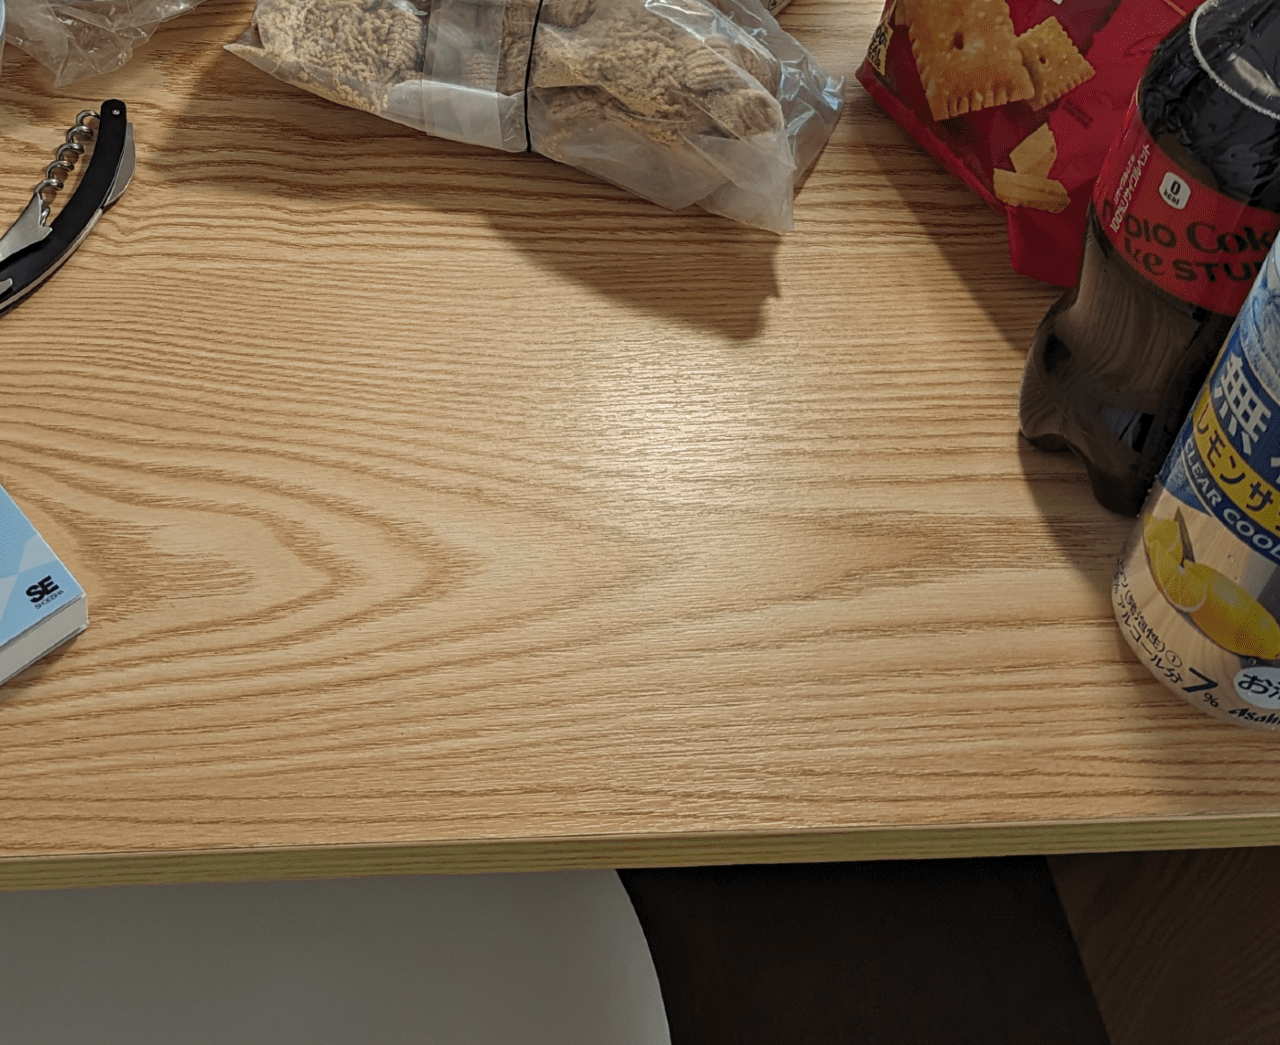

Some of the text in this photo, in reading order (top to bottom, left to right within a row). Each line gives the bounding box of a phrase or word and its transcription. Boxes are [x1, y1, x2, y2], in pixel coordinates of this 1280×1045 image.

[1163, 188, 1180, 206] kcal
[1169, 180, 1181, 196] 0
[1184, 438, 1222, 508] CLEAR
[25, 575, 59, 603] SE
